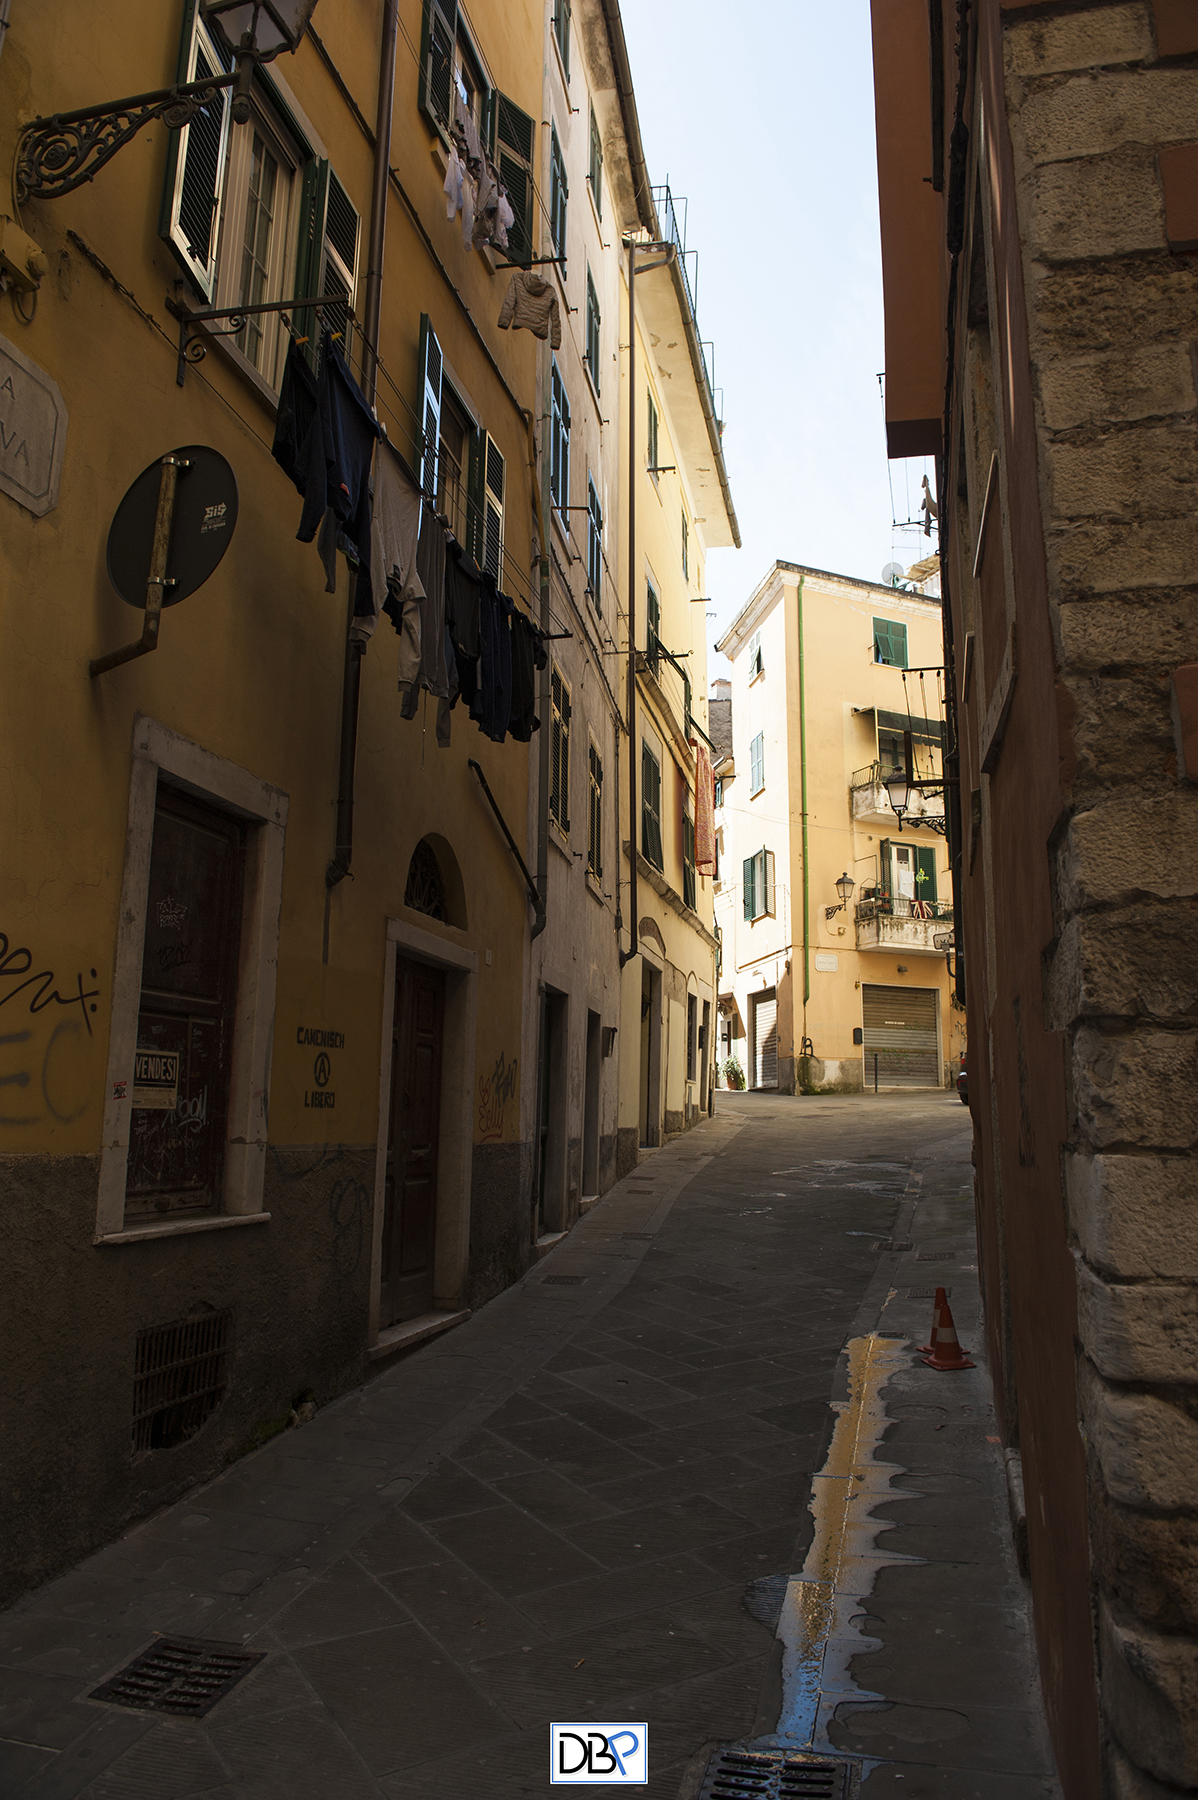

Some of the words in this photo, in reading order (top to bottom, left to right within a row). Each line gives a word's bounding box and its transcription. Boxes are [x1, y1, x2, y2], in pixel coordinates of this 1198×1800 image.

[296, 1026, 345, 1049] CAMENISCH
[134, 1056, 177, 1081] VENDESI
[304, 1090, 335, 1109] LIBERO
